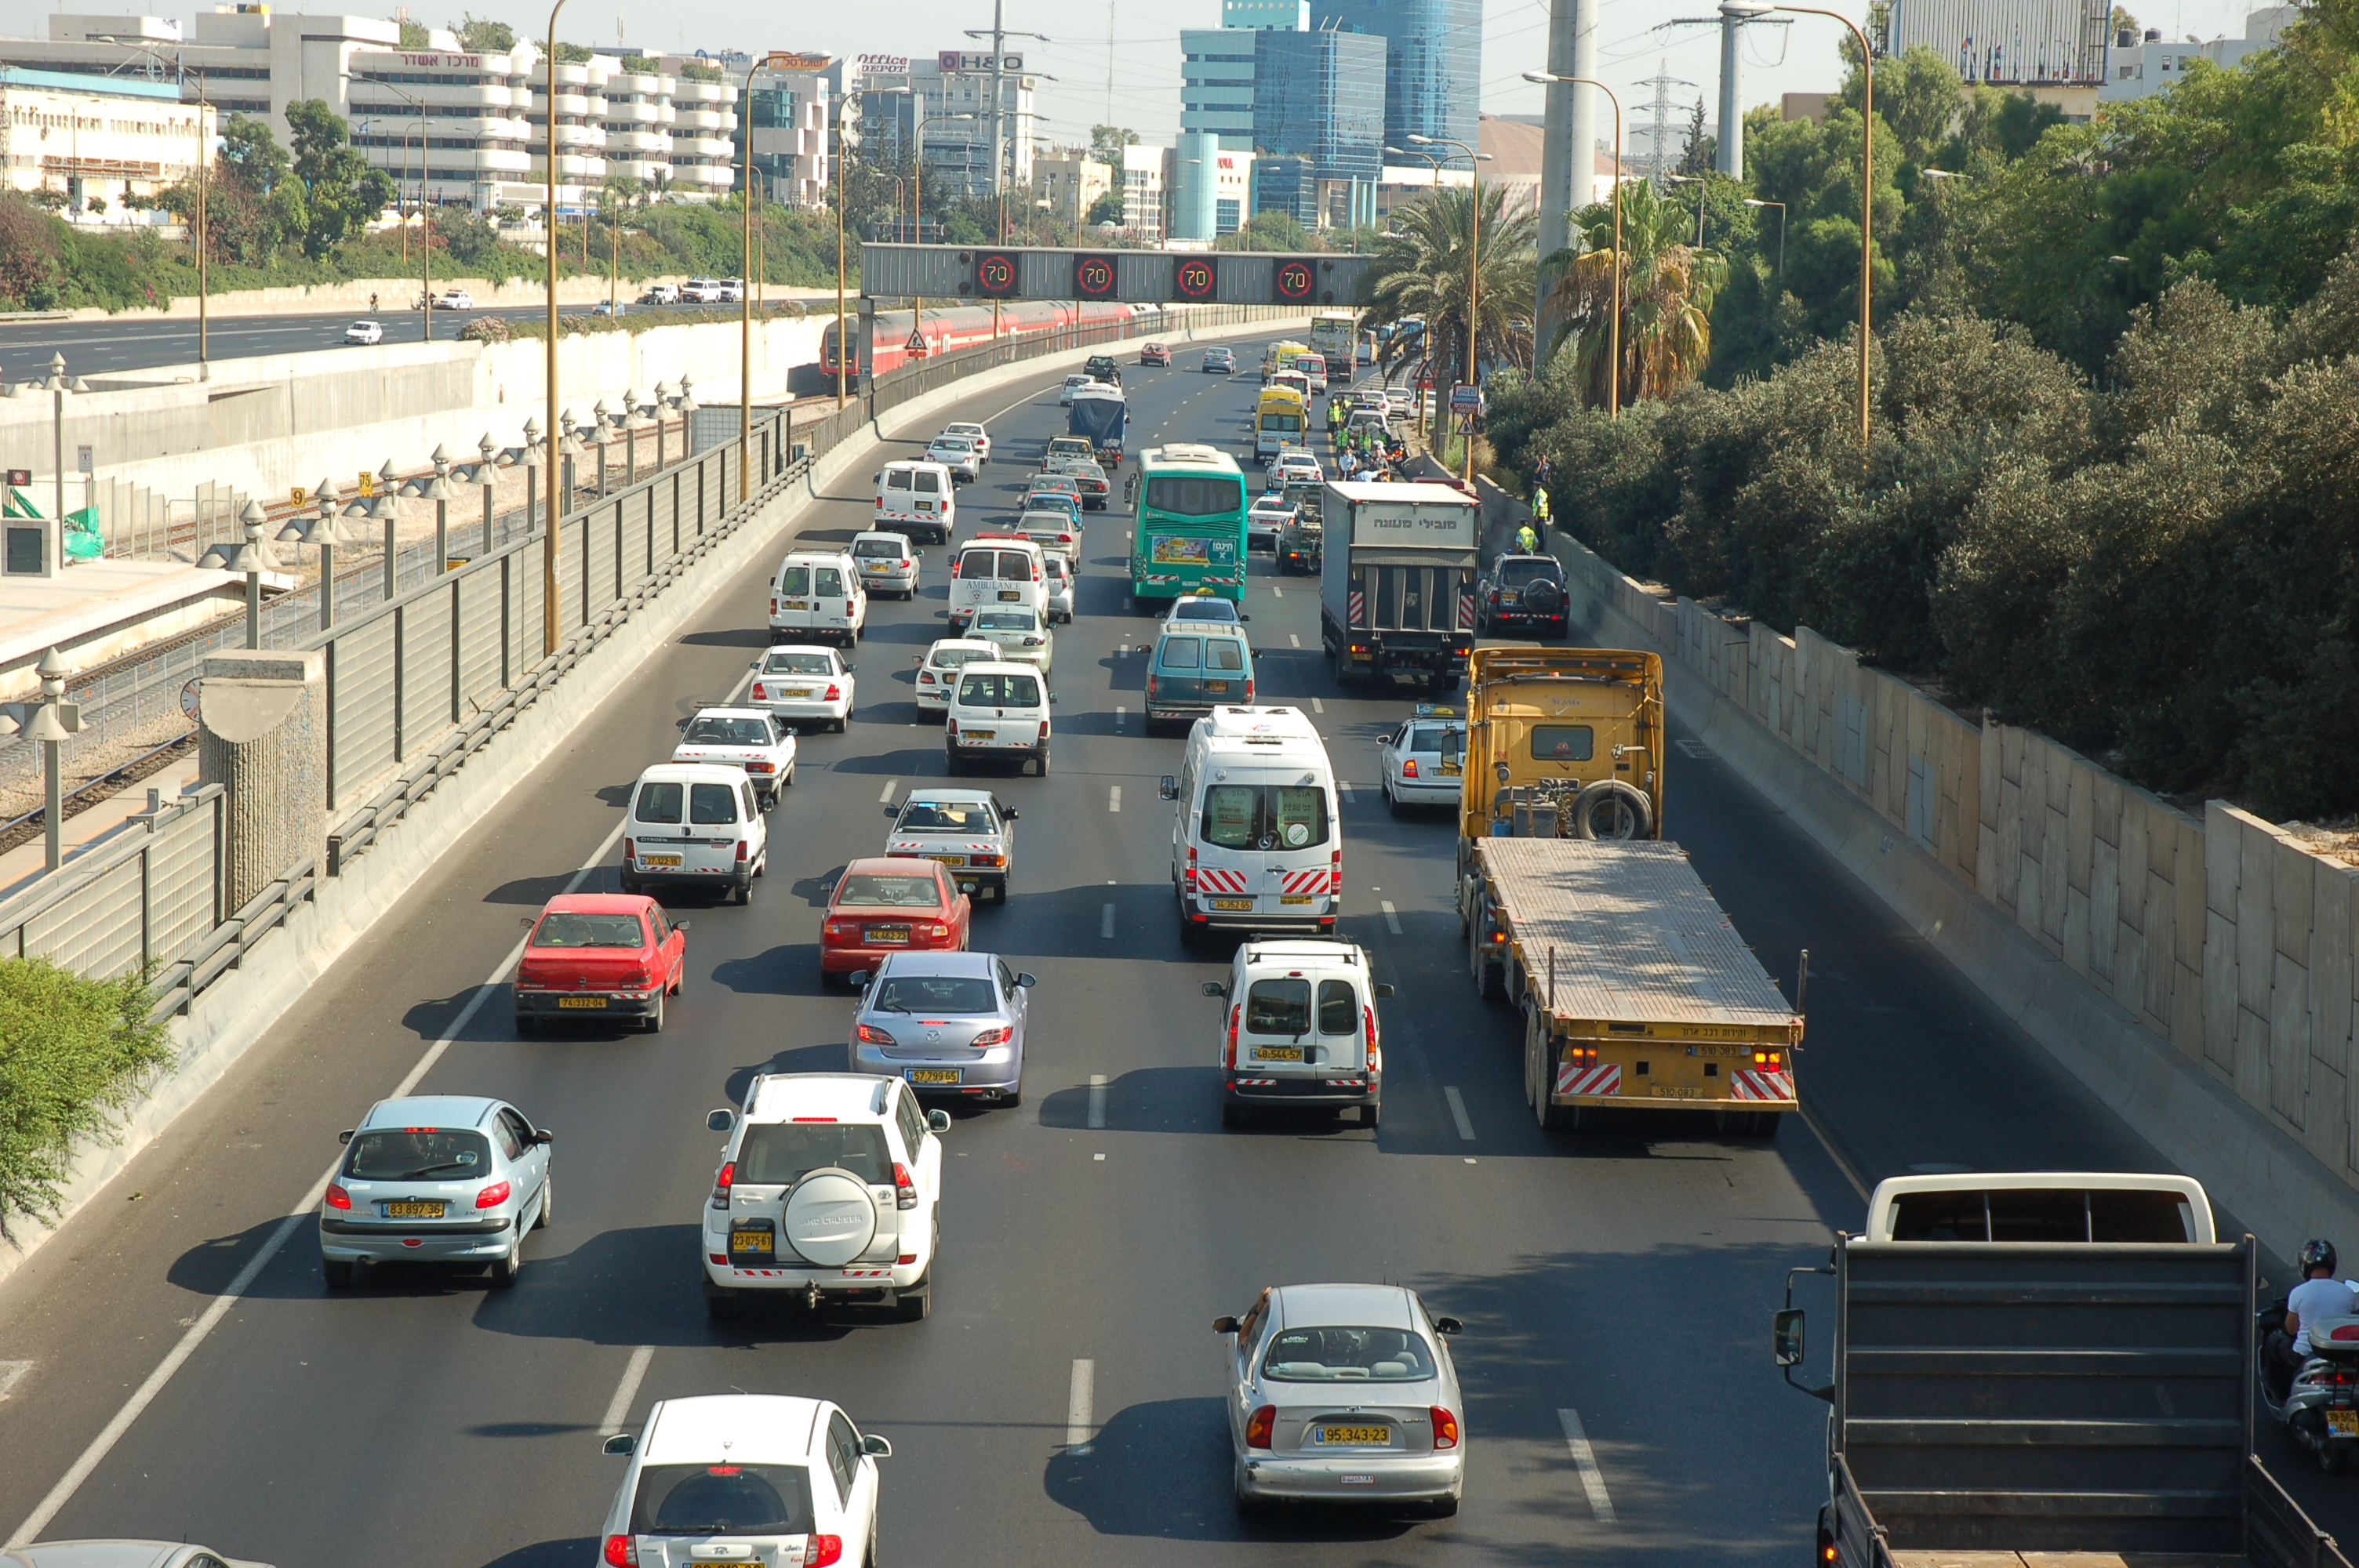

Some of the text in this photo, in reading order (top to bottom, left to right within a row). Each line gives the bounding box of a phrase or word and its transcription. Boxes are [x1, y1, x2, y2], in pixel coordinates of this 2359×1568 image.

[400, 54, 478, 67] מרכז אשדר
[857, 53, 908, 65] Office
[861, 64, 907, 73] DEPOT
[987, 266, 1007, 281] 70
[1085, 268, 1105, 283] 70
[1185, 270, 1205, 286] 70
[1285, 272, 1305, 288] 70
[293, 490, 304, 505] 9
[1419, 518, 1457, 529] מובילי
[966, 581, 1021, 590] AMBULANCE
[1703, 1028, 1718, 1036] רכב
[1721, 1029, 1747, 1037] זהירות
[822, 1215, 863, 1224] CRUISER
